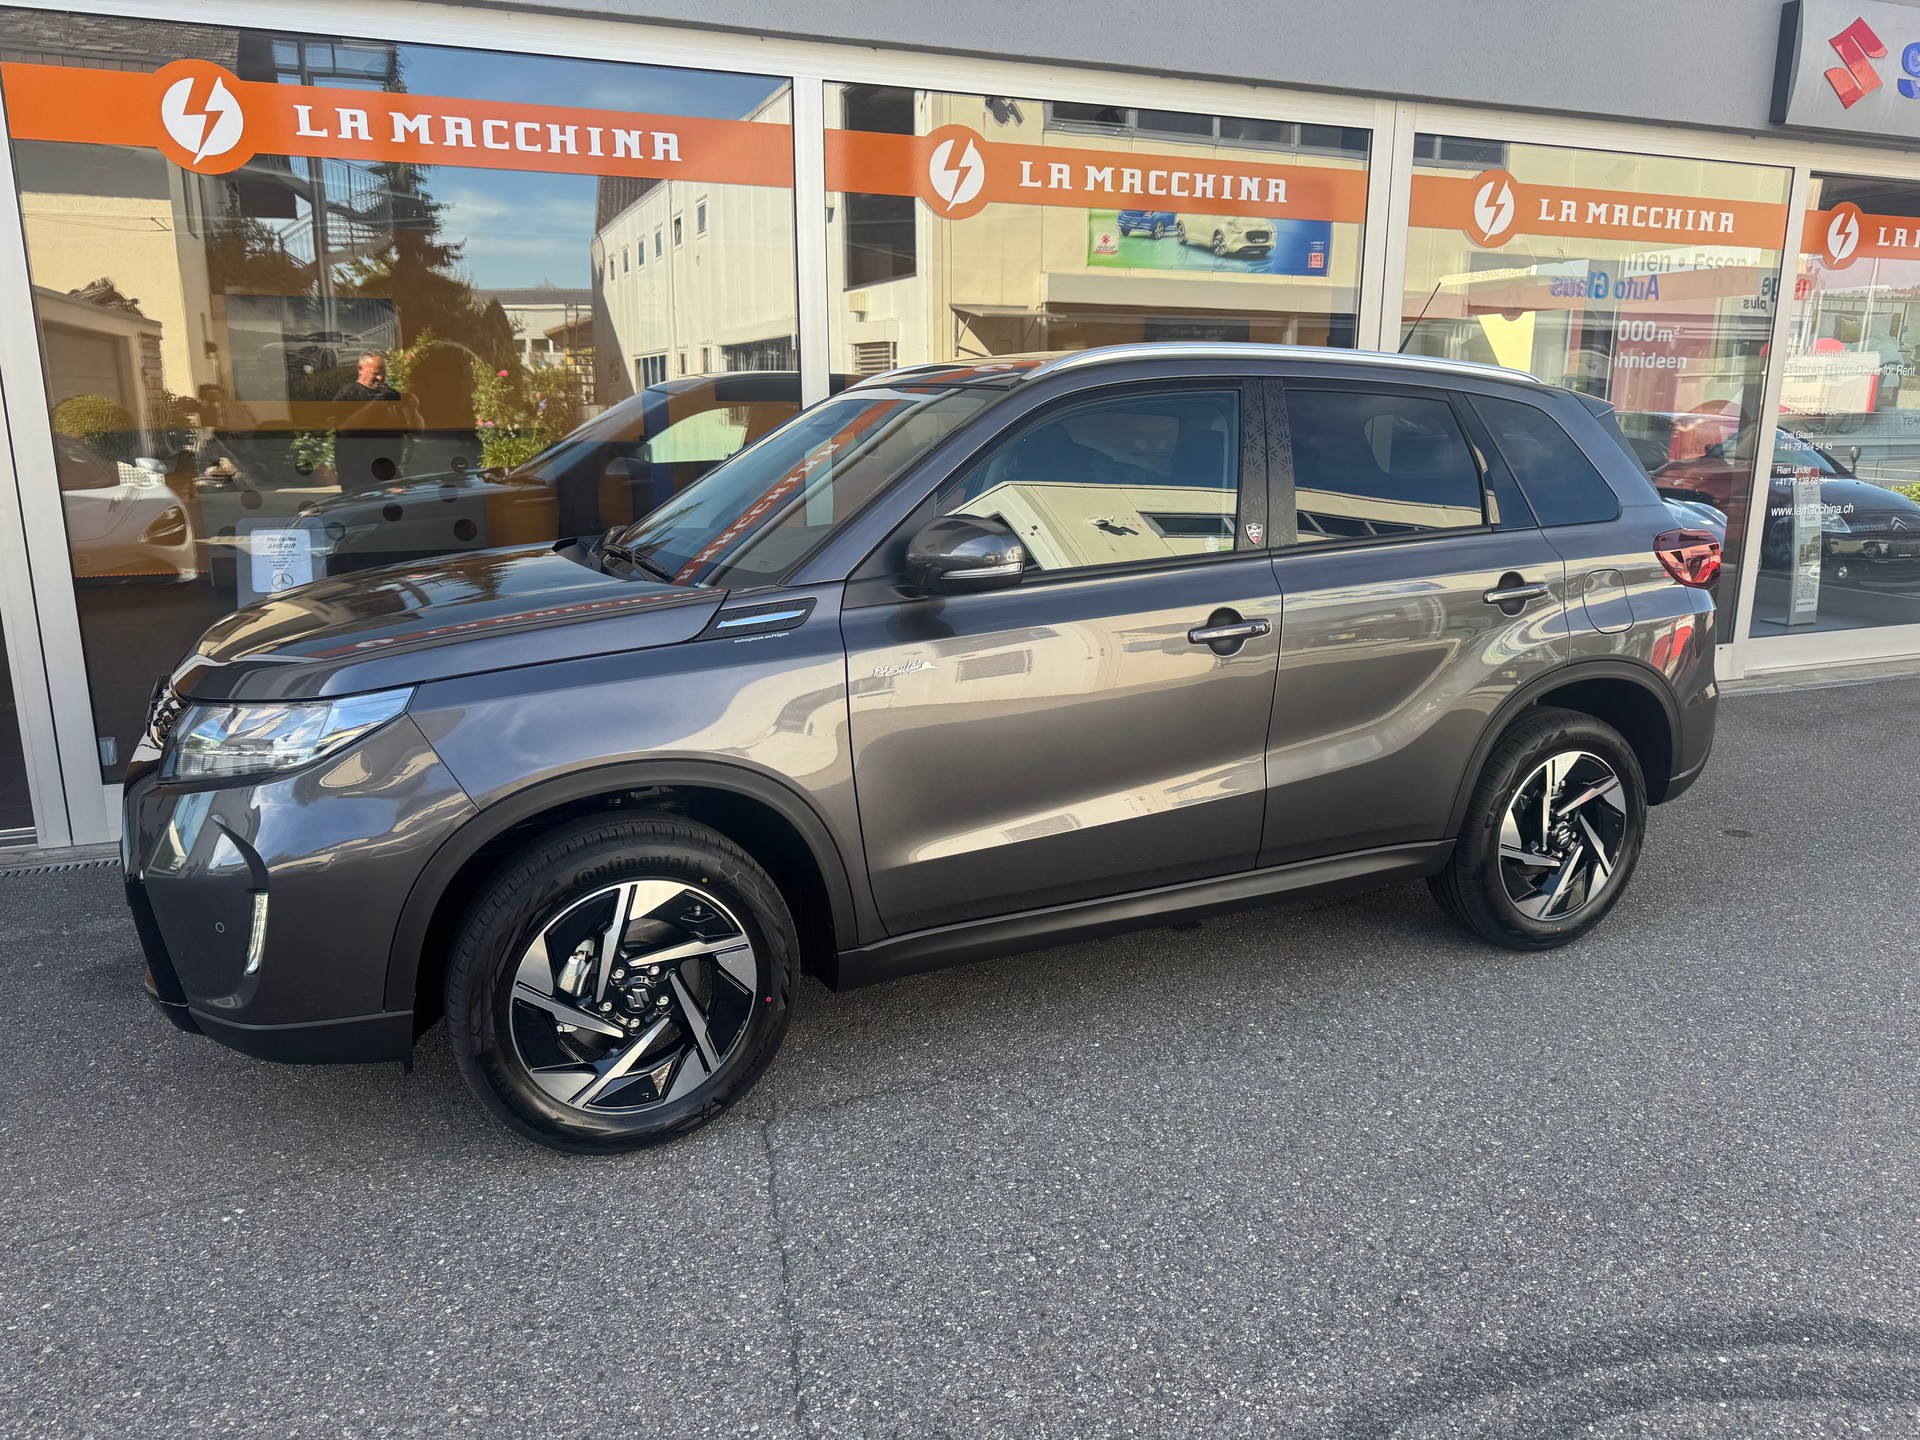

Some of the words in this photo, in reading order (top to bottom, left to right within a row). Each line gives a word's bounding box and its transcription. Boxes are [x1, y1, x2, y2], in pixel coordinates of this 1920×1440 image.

[293, 104, 374, 141] LA
[388, 111, 683, 162] MACCHINA
[1019, 160, 1073, 190] LA
[1084, 165, 1288, 203] MACCHINA
[1536, 198, 1577, 223] LA
[1585, 202, 1735, 234] MACCHINA
[1876, 226, 1908, 248] LA
[1896, 364, 1916, 376] Rent
[1796, 430, 1814, 439] Glaus
[1771, 502, 1854, 517] www.lamacchina.ch
